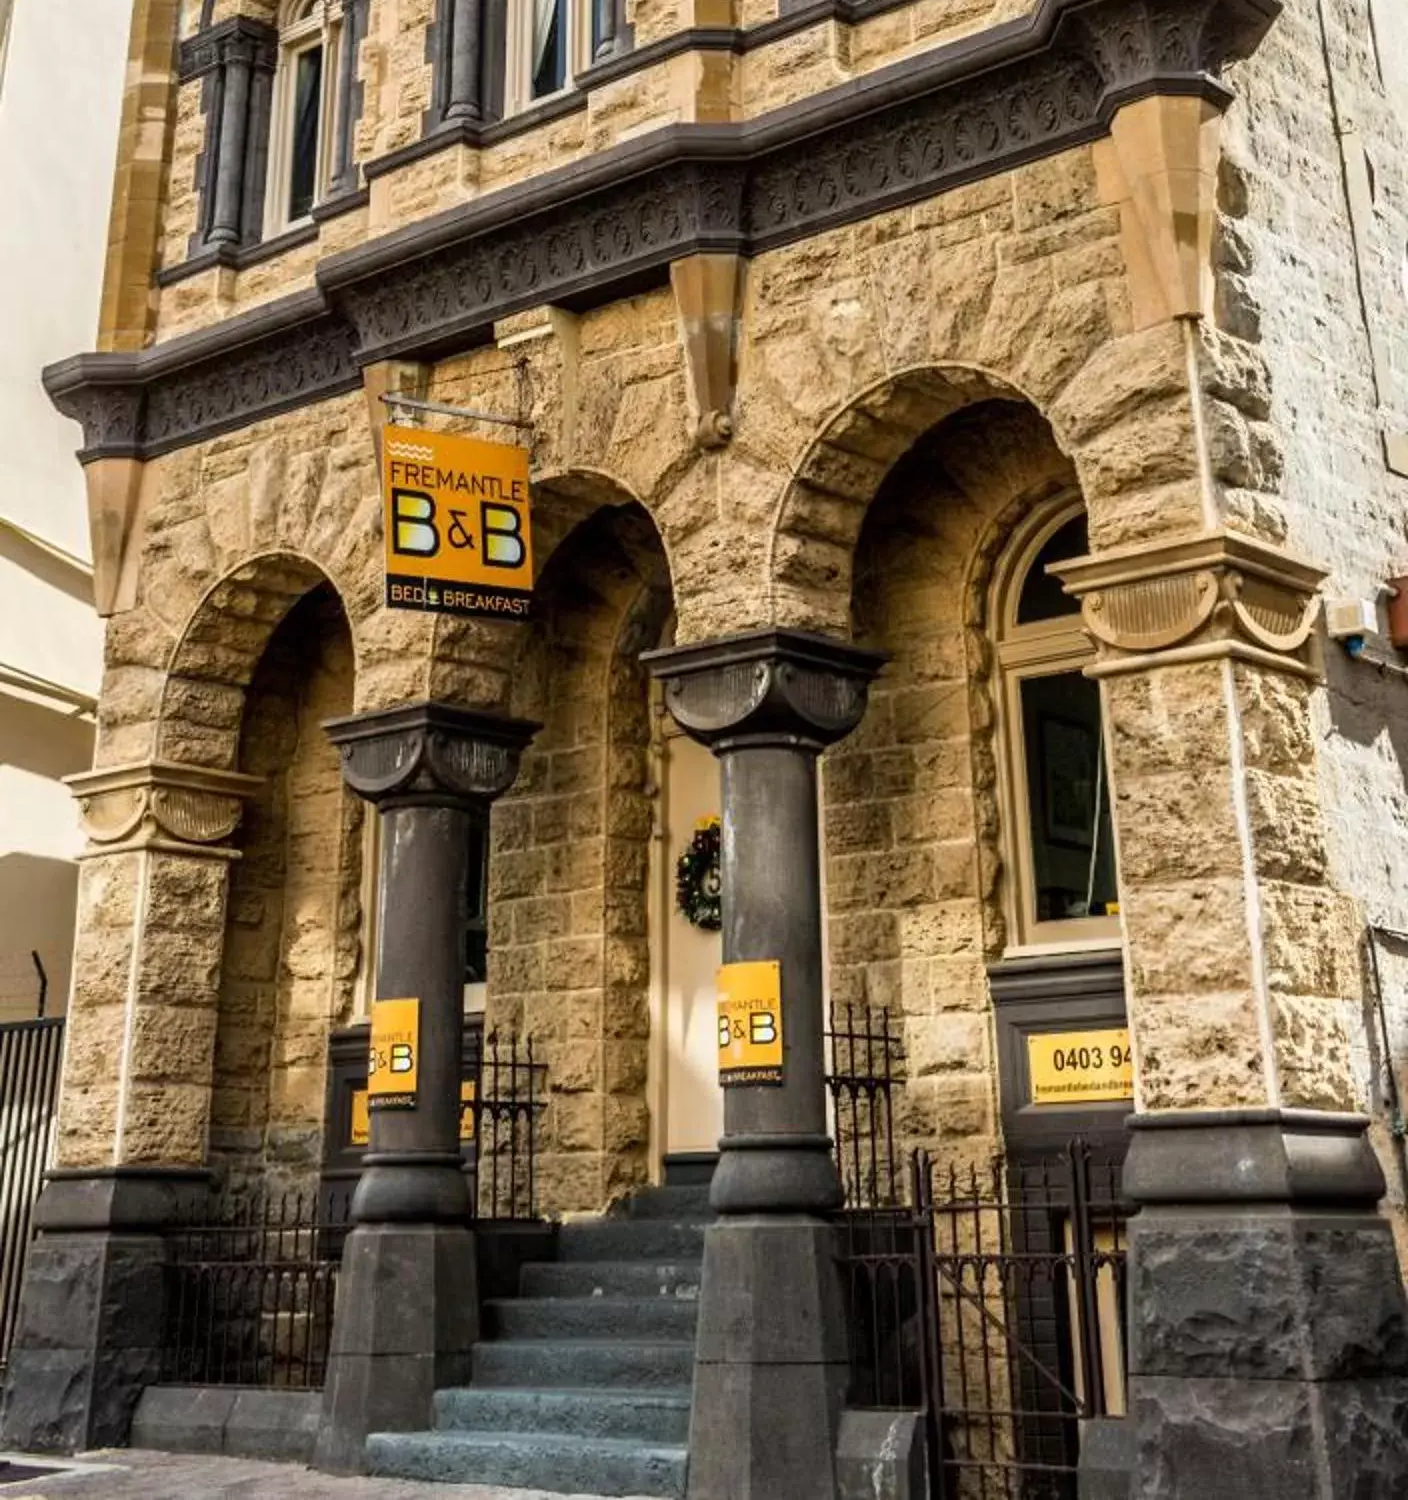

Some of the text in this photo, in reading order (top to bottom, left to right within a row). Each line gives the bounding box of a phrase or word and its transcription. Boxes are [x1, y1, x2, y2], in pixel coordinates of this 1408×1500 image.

[391, 461, 525, 503] FREMANTLE
[391, 487, 527, 570] B & B
[391, 585, 531, 615] BED BREAKFAST
[749, 1011, 777, 1045] B
[389, 1043, 414, 1074] B
[1053, 1046, 1104, 1072] 0403
